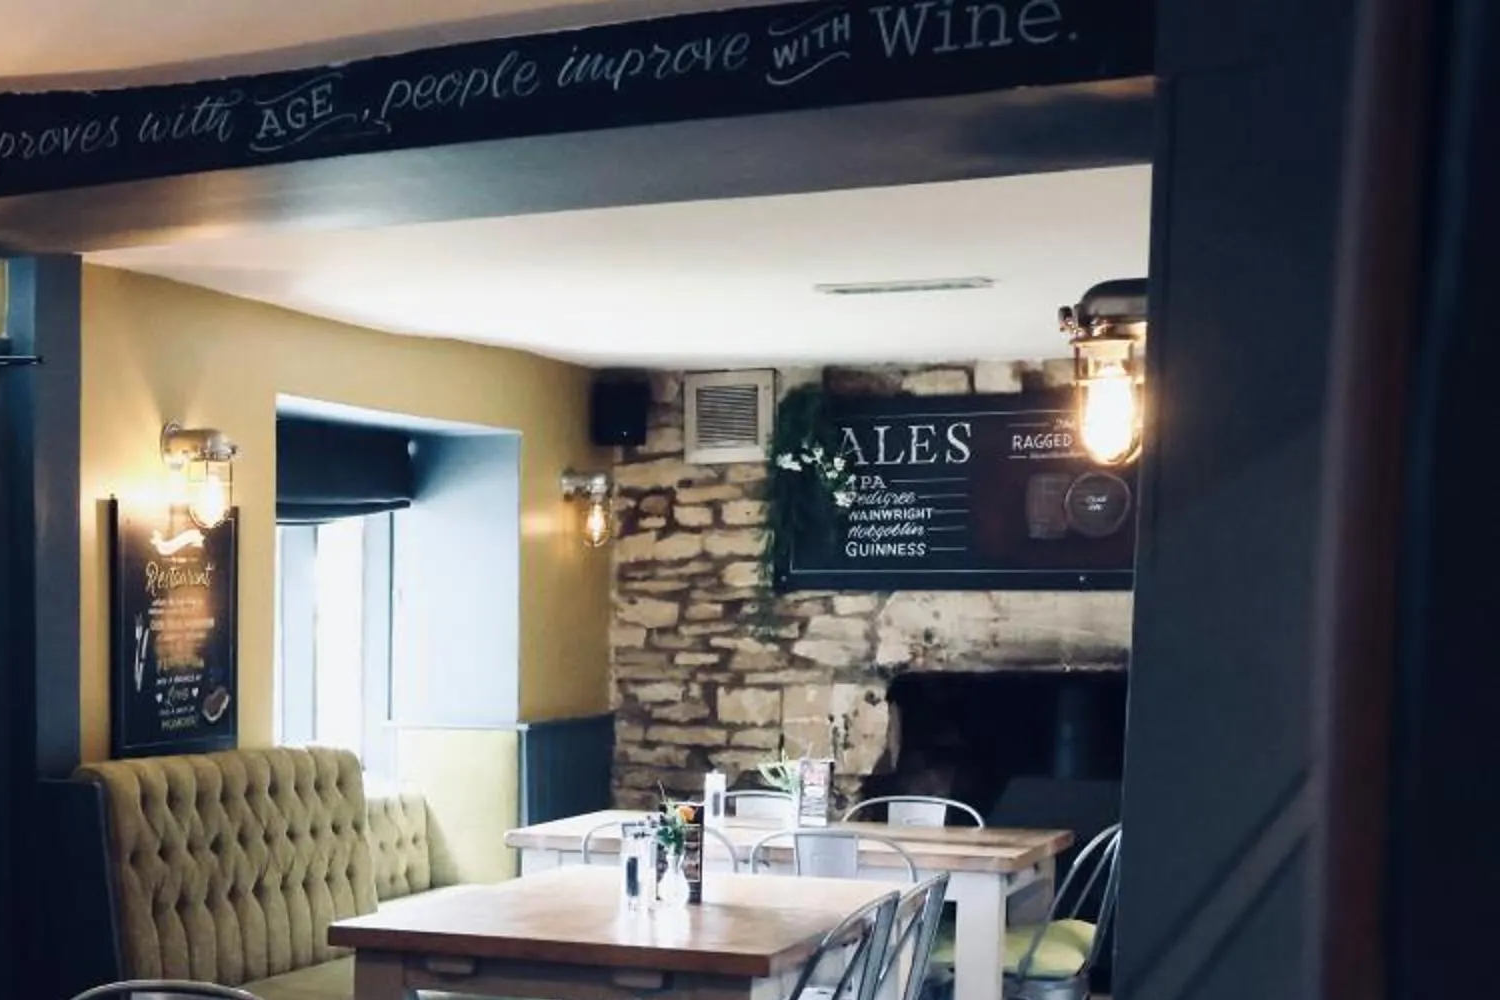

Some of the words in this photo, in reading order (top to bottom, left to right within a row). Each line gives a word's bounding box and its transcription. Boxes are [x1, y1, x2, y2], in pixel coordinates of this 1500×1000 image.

[138, 86, 244, 144] with
[380, 51, 540, 118] people
[556, 30, 750, 91] improve
[773, 12, 852, 69] WITH
[871, 0, 1079, 58] Wine.
[840, 421, 973, 465] ALES
[1011, 433, 1073, 451] RAGGED
[849, 507, 933, 521] WAINWRIGHT
[845, 541, 927, 557] GUINNESS
